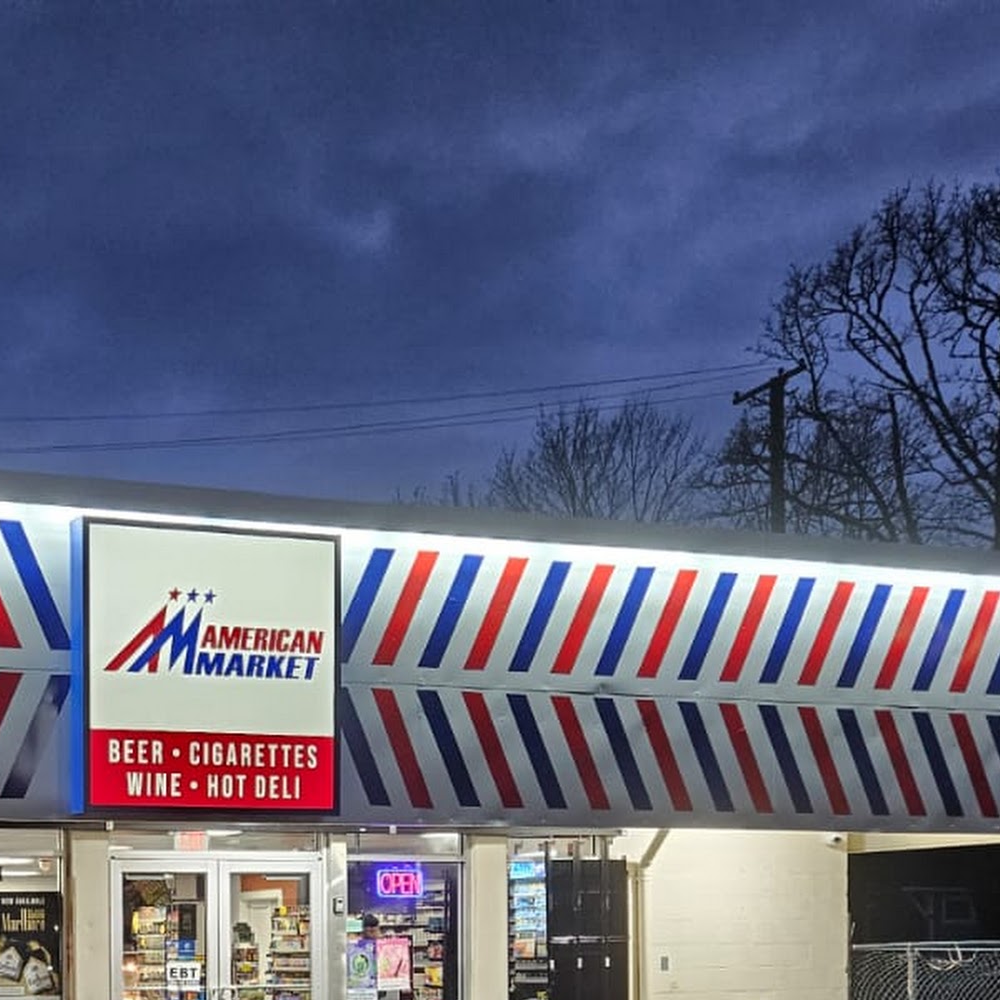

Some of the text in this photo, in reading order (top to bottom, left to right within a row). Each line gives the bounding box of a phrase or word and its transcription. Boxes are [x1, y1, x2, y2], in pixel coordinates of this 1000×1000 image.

[201, 624, 324, 654] AMERICAN
[195, 652, 320, 680] MARKET
[108, 739, 318, 769] BEER CIGARETTES
[126, 772, 301, 800] WINE HOT DELI
[380, 873, 420, 895] OPEN
[169, 967, 198, 978] EBT
